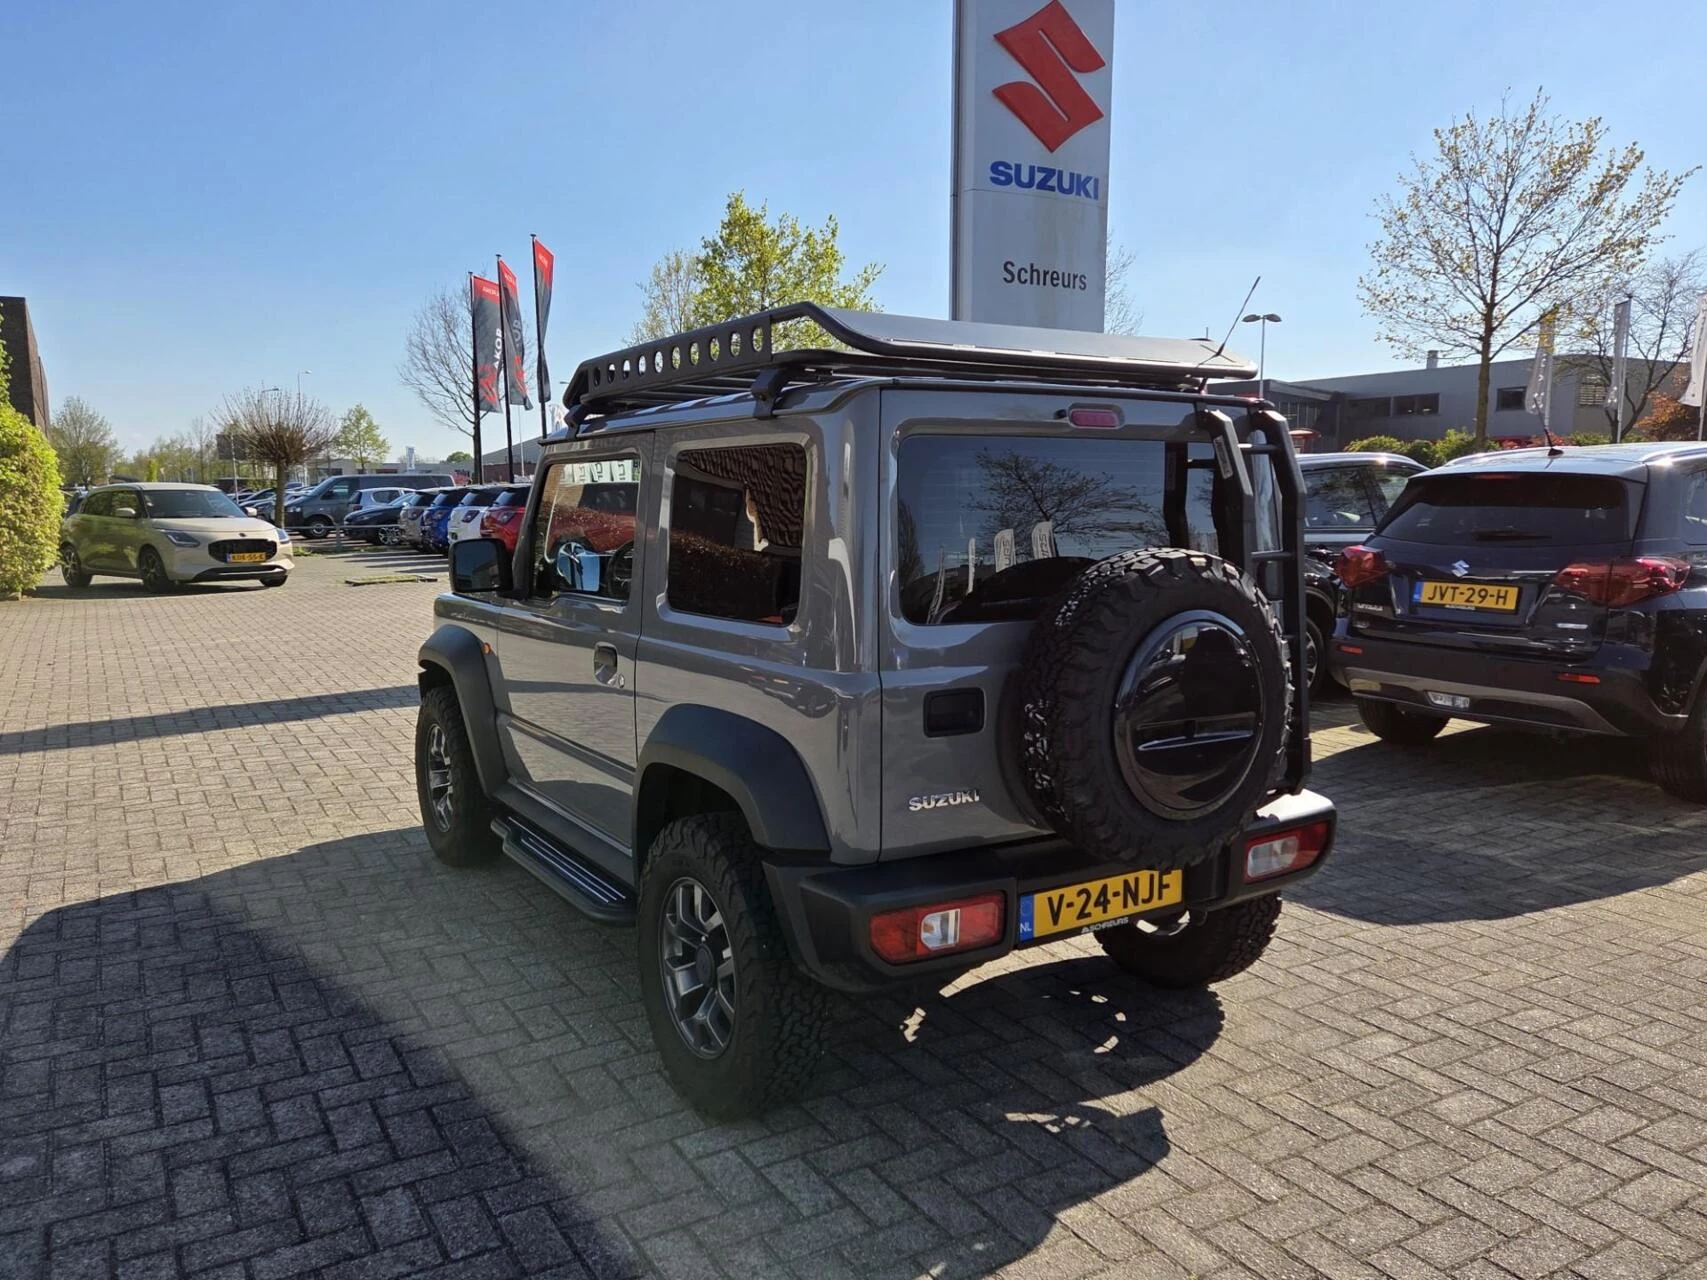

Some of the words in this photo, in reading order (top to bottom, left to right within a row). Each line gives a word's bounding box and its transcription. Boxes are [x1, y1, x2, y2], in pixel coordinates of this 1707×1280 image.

[989, 160, 1099, 201] SUZUKI
[1002, 260, 1088, 291] Schreurs
[1427, 584, 1509, 606] JVT-29-H
[908, 790, 980, 812] SUZUKI
[1047, 871, 1172, 926] V-24-NJF
[1019, 921, 1033, 934] NL
